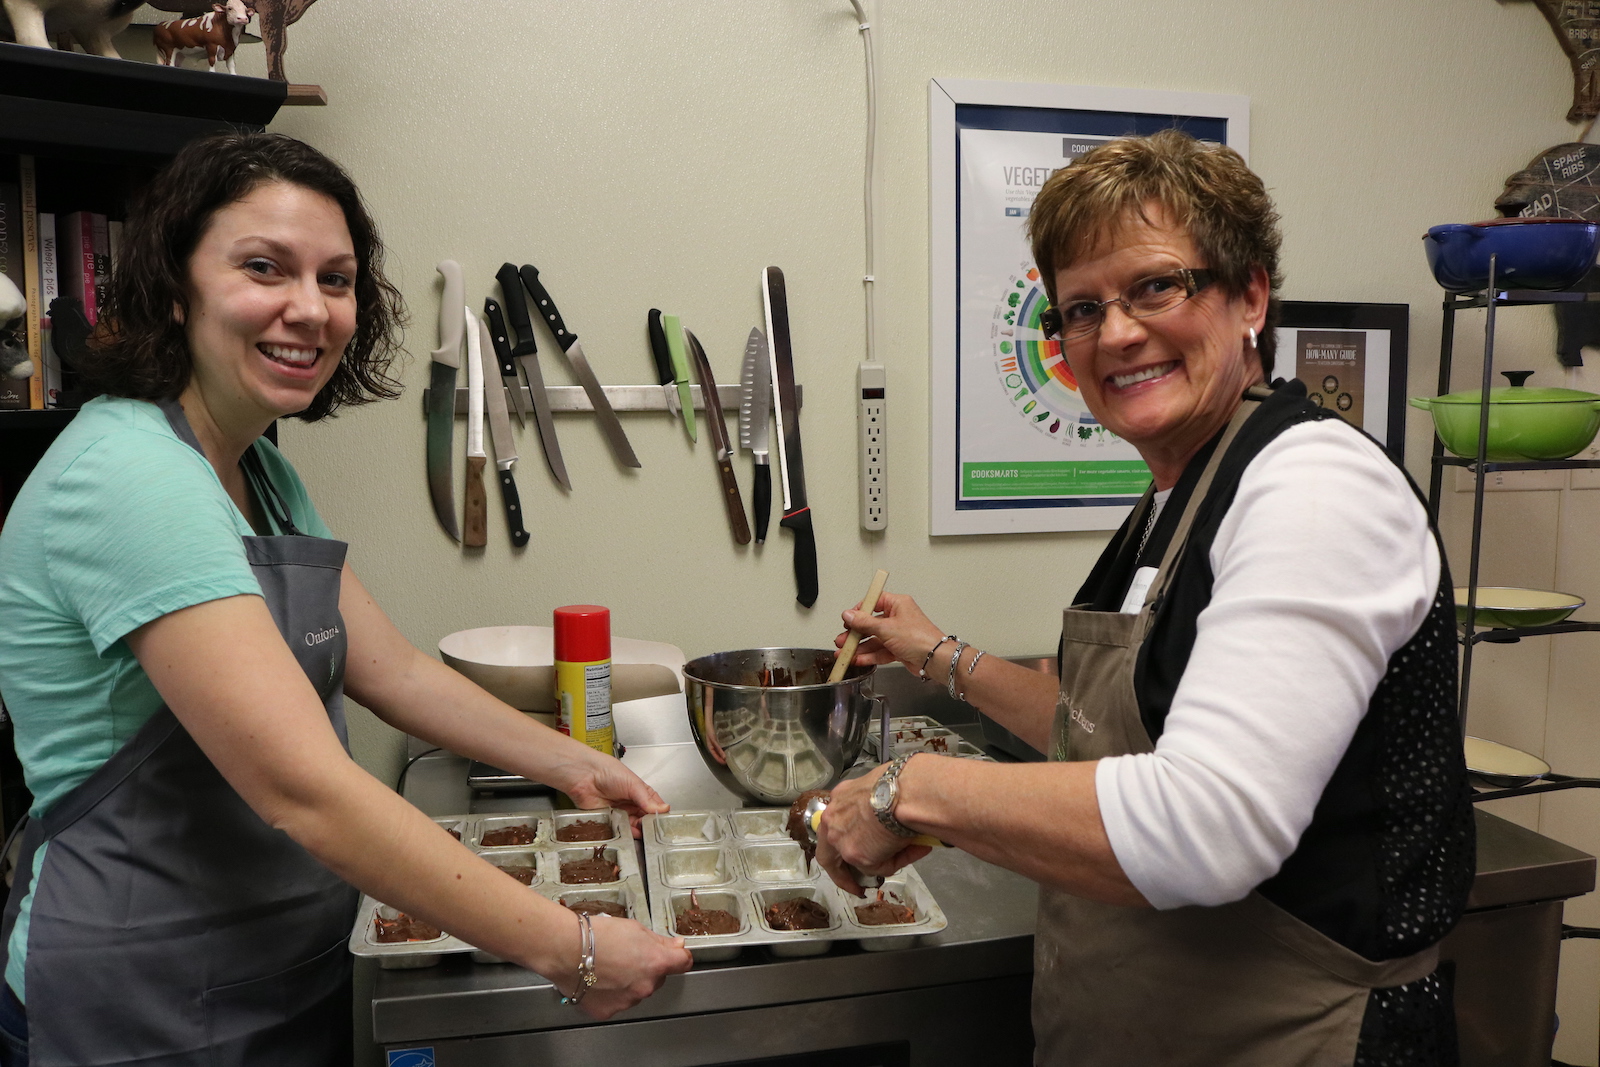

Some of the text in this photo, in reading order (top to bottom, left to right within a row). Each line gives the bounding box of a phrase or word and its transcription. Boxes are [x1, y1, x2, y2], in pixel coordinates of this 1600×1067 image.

[1553, 147, 1586, 170] SPARE
[1562, 160, 1585, 179] RIBS
[44, 238, 55, 295] Whoopie pies
[82, 235, 95, 284] pie pie pie
[1305, 349, 1357, 360] HOW-MANY GUIDE
[971, 469, 1019, 478] COOKSMARTS
